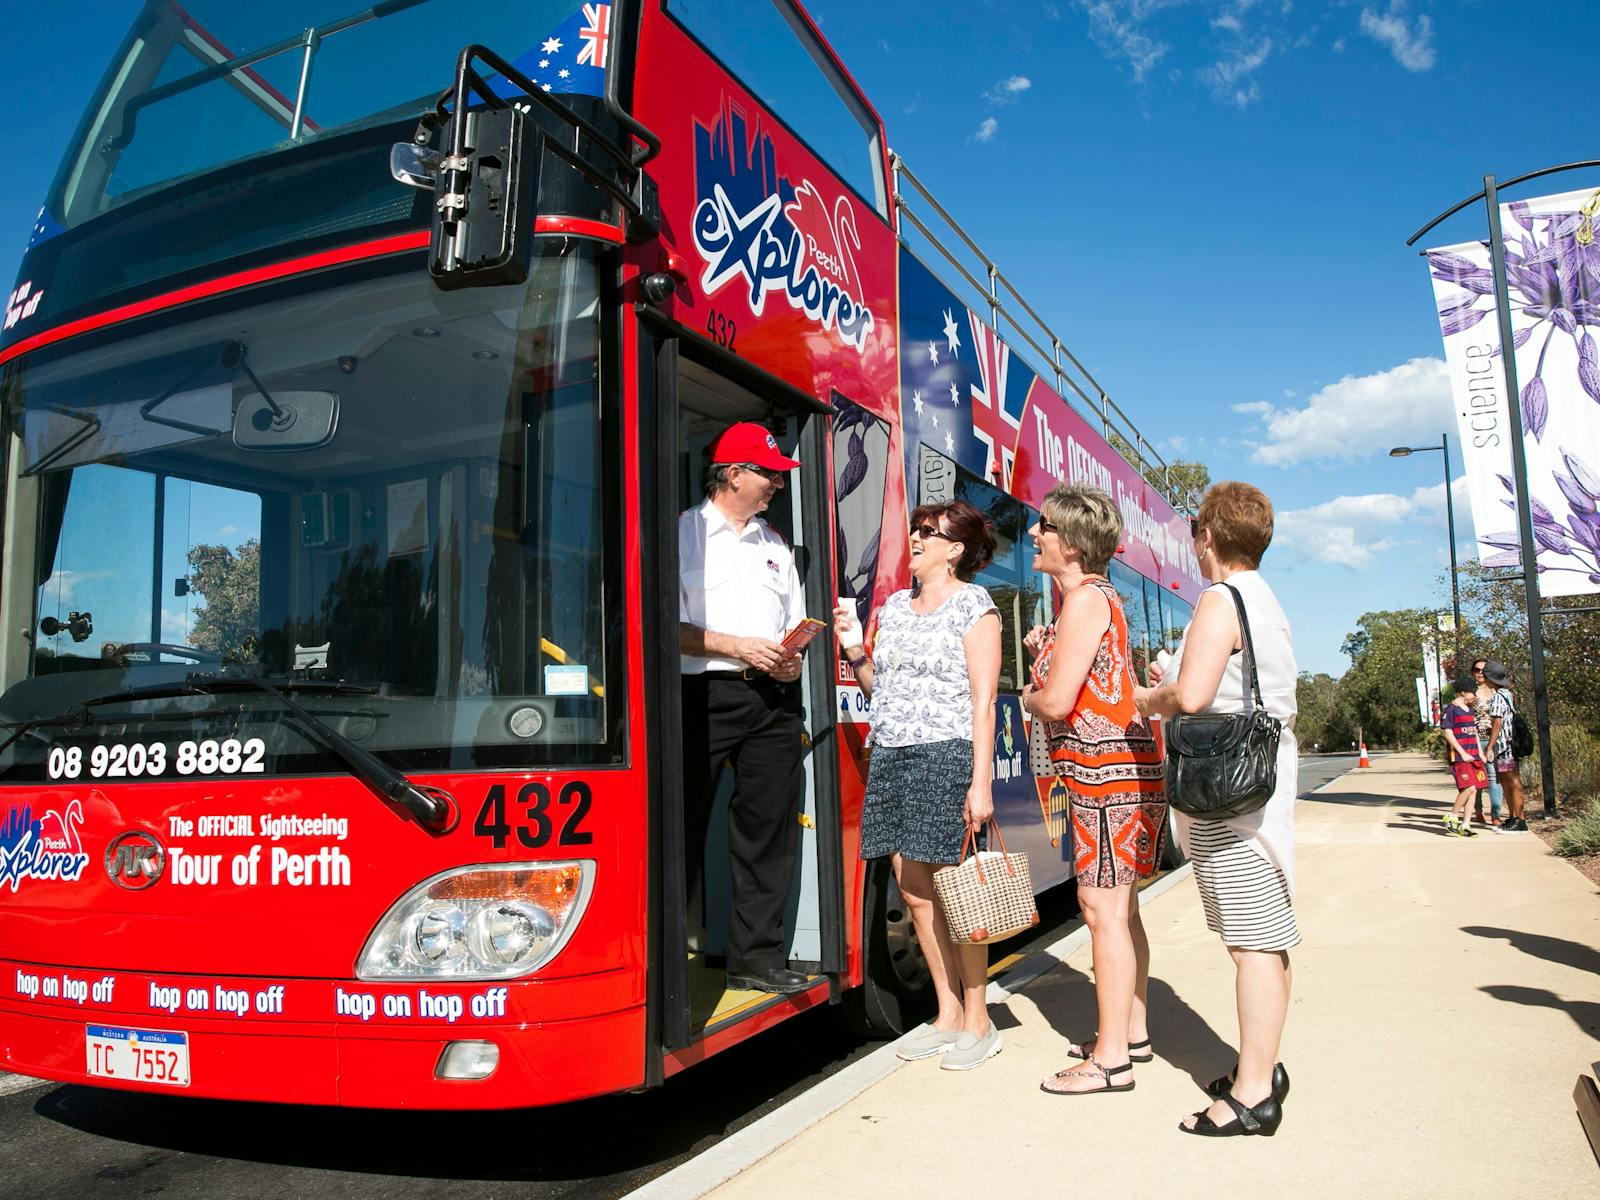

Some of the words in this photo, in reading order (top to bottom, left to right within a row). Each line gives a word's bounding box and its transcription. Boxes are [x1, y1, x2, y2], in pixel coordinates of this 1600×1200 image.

[806, 233, 843, 280] Perth
[707, 308, 737, 353] 432
[1462, 343, 1500, 448] science
[1033, 403, 1065, 481] The
[49, 747, 82, 779] 08
[90, 742, 166, 778] 9203
[176, 738, 266, 775] 8882
[996, 754, 1010, 784] hop
[1011, 751, 1022, 778] off
[169, 816, 193, 838] The
[198, 815, 254, 838] OFFICIAL
[259, 813, 349, 841] Sightseeing
[473, 781, 594, 849] 432
[44, 837, 67, 850] Perth
[168, 847, 222, 886] Tour
[232, 846, 262, 885] of
[271, 846, 351, 886] Perth
[16, 969, 39, 999] hop
[42, 977, 59, 998] on
[62, 974, 88, 1005] hop
[92, 976, 115, 1004] off
[149, 981, 181, 1014] hop
[186, 988, 209, 1010] on
[215, 985, 249, 1016] hop
[255, 986, 285, 1014] off
[336, 987, 376, 1021] hop
[382, 994, 412, 1017] on
[419, 989, 463, 1023] hop
[470, 987, 508, 1018] off
[93, 1042, 115, 1075] TC
[132, 1047, 179, 1081] 7552
